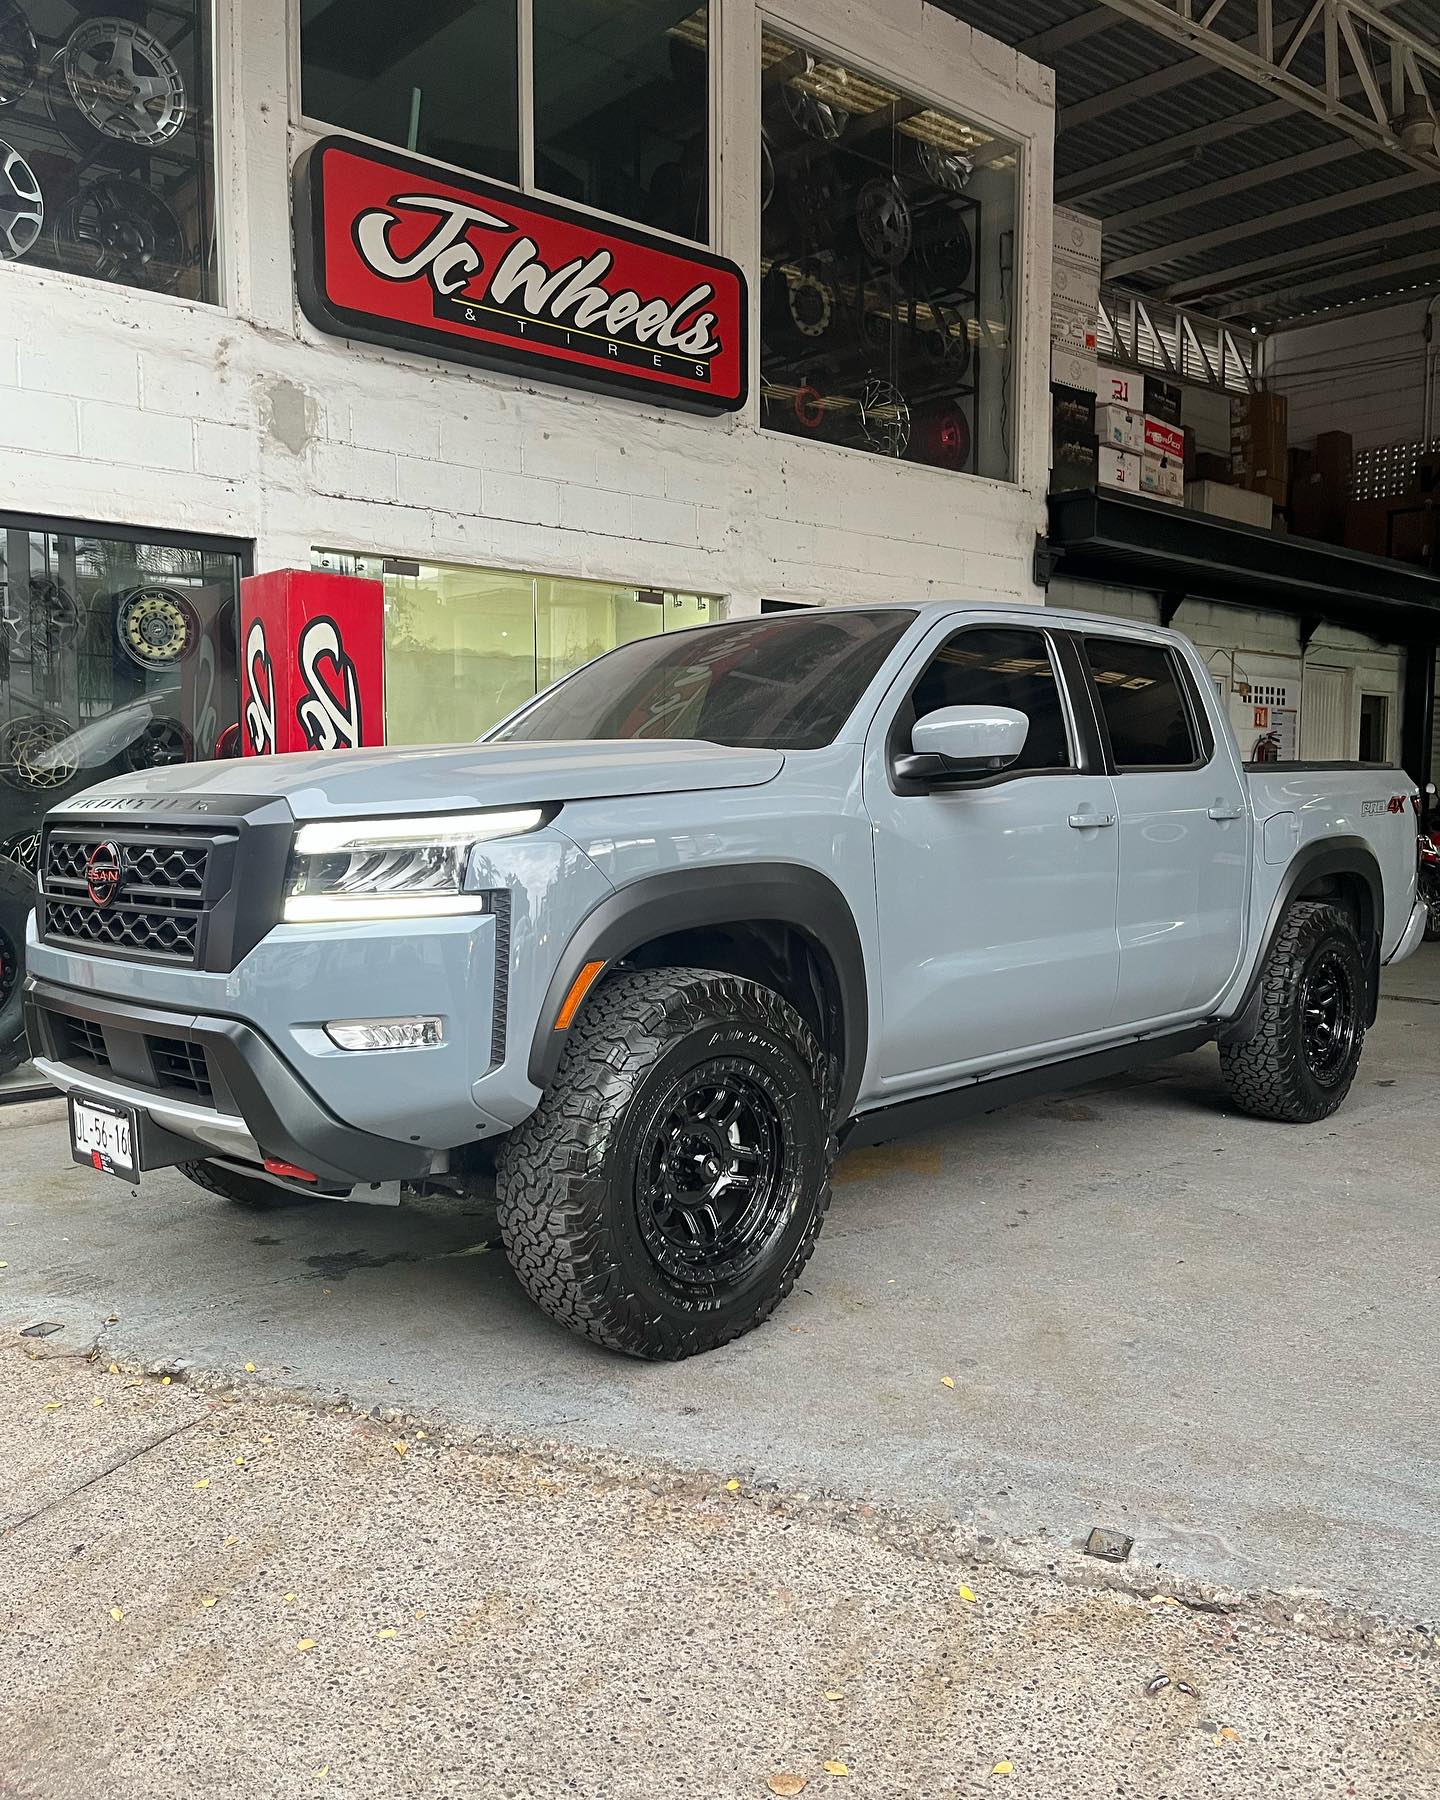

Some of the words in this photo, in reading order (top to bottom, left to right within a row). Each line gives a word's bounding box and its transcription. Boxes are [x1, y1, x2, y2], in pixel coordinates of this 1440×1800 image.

[464, 307, 477, 323] &
[517, 320, 705, 378] TIRES
[490, 237, 718, 355] Wheels
